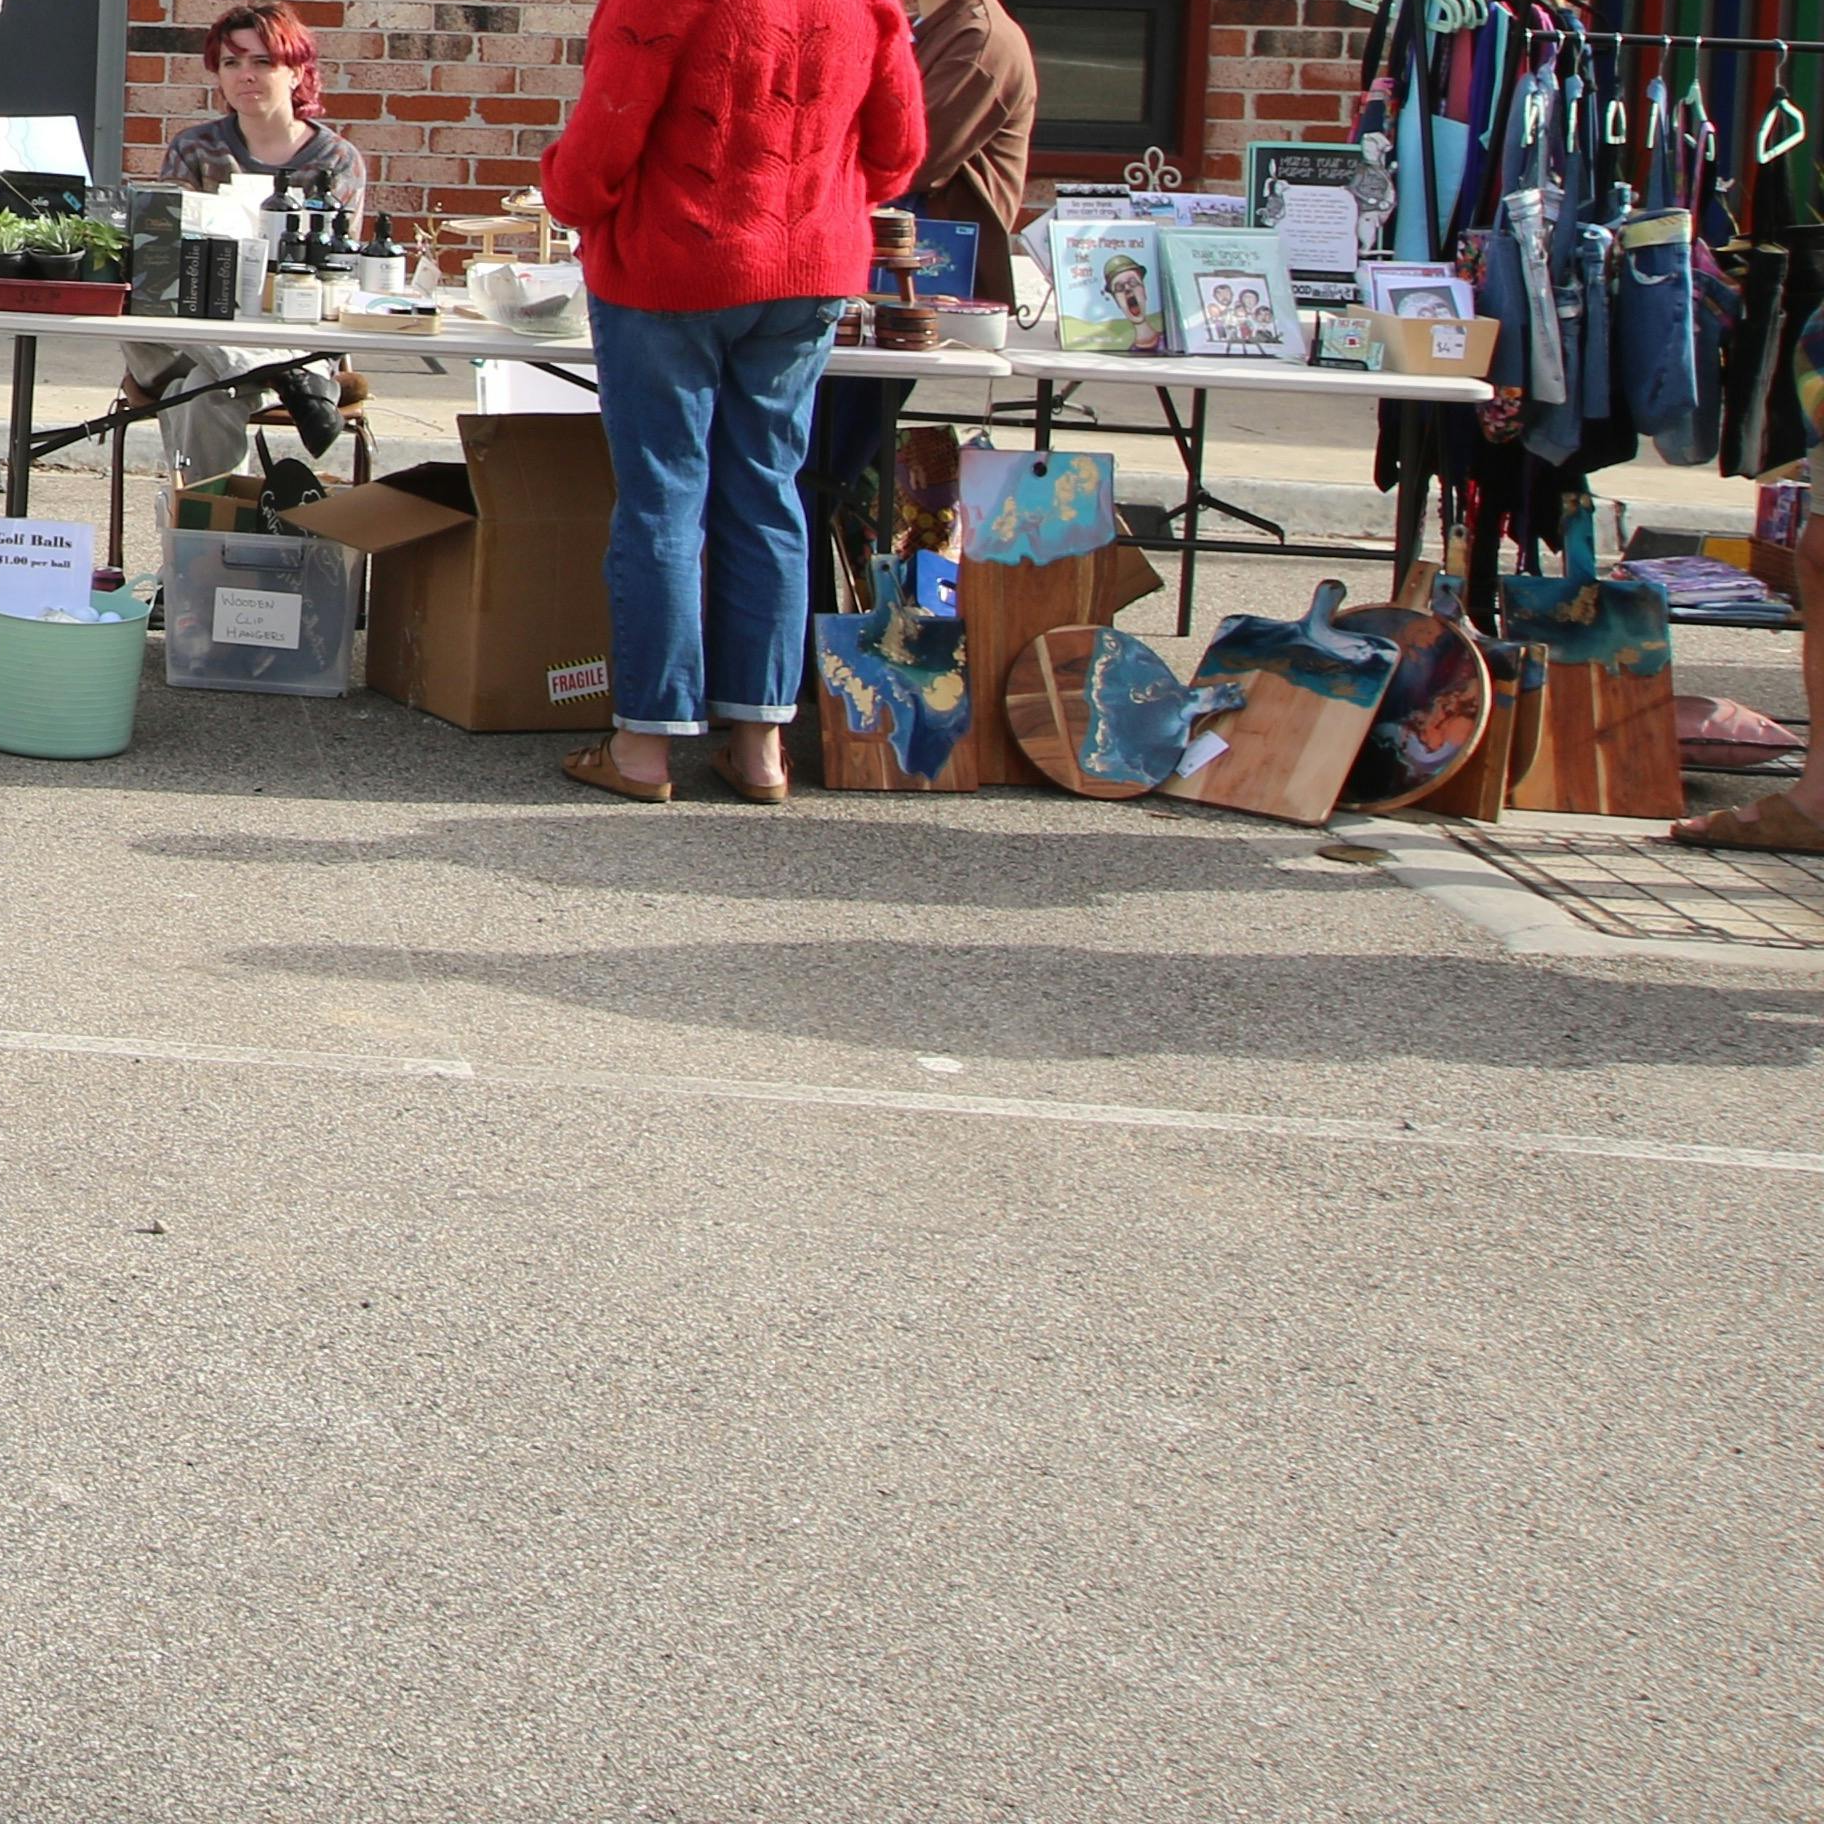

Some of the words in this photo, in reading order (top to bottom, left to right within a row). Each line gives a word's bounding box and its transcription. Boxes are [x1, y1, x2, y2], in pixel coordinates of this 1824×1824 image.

[31, 534, 73, 549] Balls
[30, 559, 48, 568] per
[50, 559, 72, 569] ball
[551, 667, 605, 694] FRAGILE
